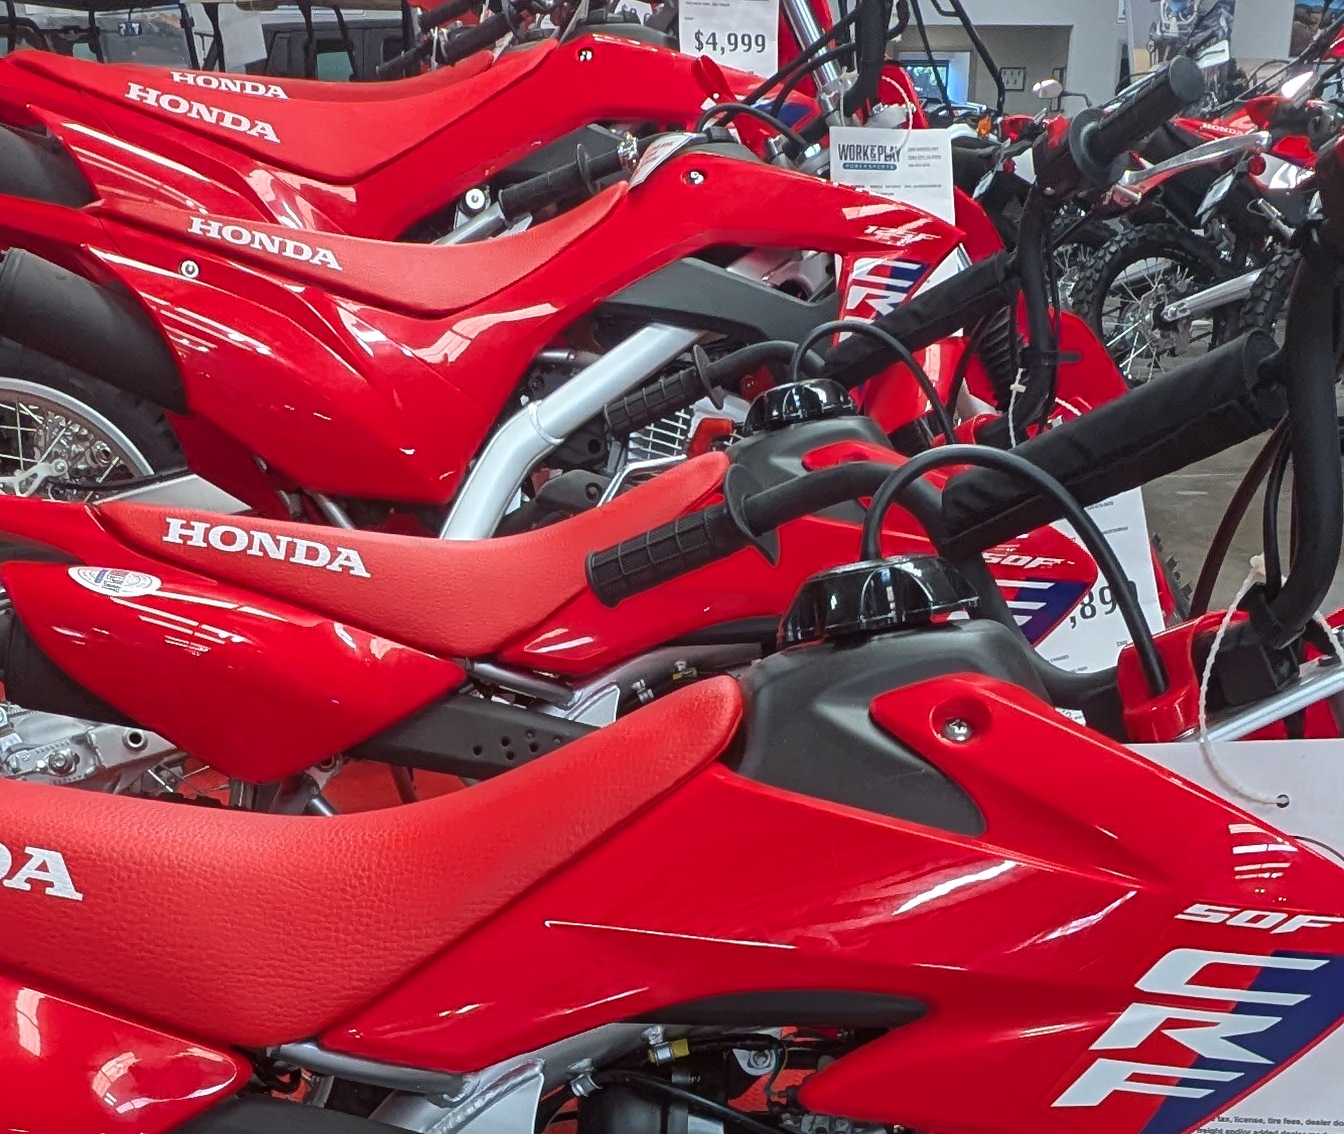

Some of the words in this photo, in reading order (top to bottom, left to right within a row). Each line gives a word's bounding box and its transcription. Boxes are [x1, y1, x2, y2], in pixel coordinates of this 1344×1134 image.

[694, 29, 766, 55] $4,999
[125, 82, 281, 144] HONDA
[170, 70, 289, 100] HONDA
[187, 215, 344, 272] HONDA
[162, 517, 371, 578] HONDA
[1053, 948, 1331, 1107] CRF
[1283, 1117, 1303, 1125] fees,
[1305, 1118, 1331, 1126] dealer
